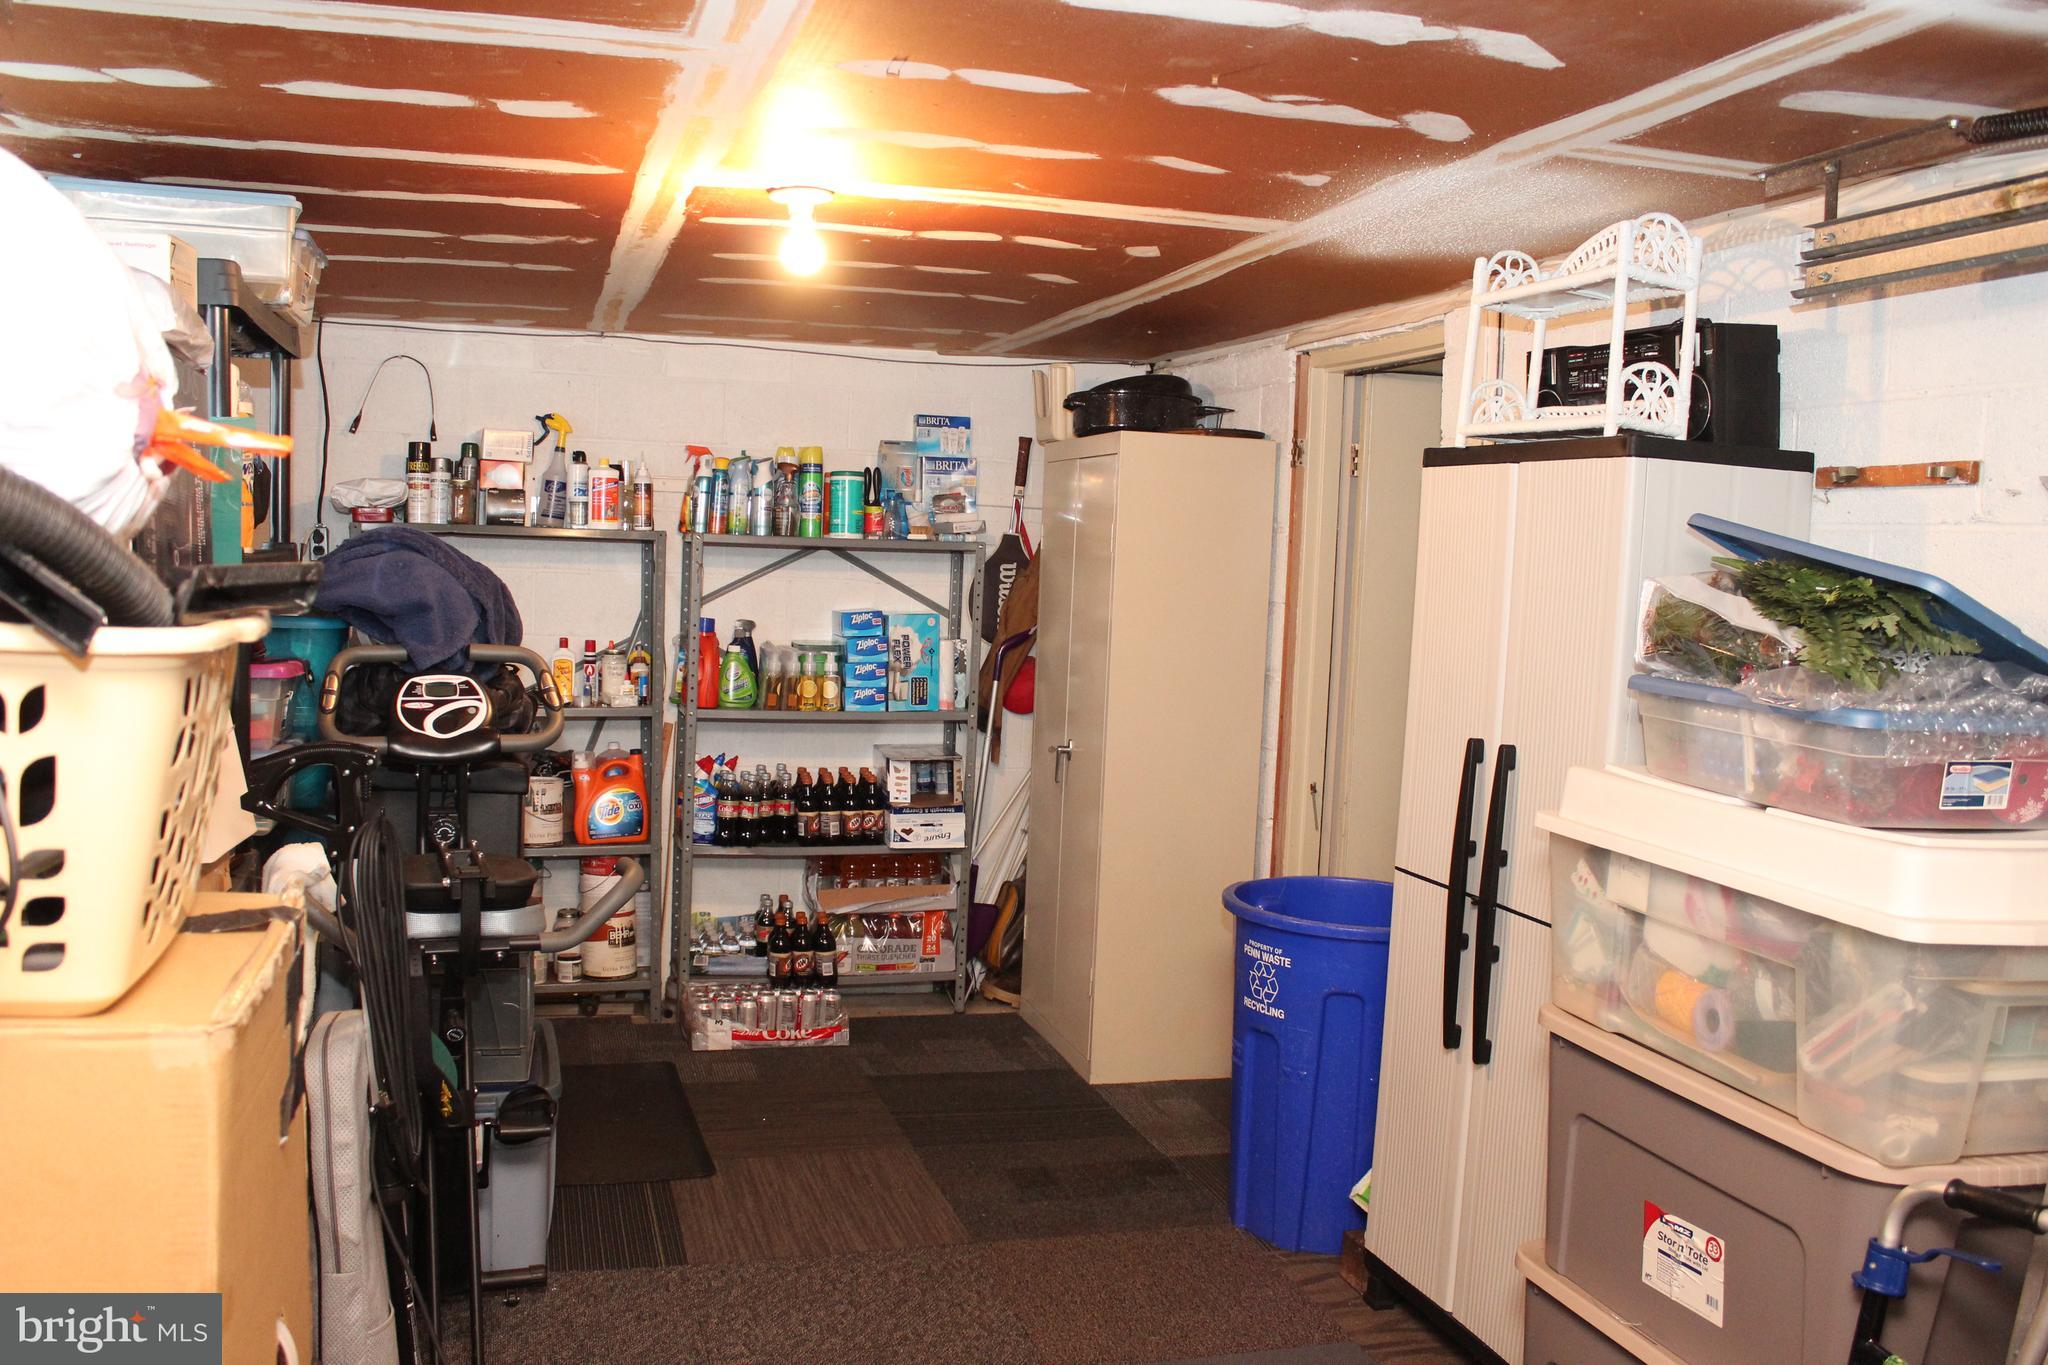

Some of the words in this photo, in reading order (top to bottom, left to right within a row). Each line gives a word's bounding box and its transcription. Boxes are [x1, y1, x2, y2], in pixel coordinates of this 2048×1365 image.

[926, 417, 950, 426] BRITA
[935, 460, 968, 471] BRITA
[996, 562, 1017, 631] Wil
[851, 612, 873, 624] Ziploc
[856, 638, 879, 651] Ziploc
[893, 639, 901, 663] FLEX
[901, 635, 911, 669] POWER
[854, 663, 877, 675] Ziploc
[854, 687, 877, 700] Ziploc
[599, 803, 620, 819] Tide
[628, 802, 642, 810] OXI
[923, 832, 951, 842] Ensure
[857, 945, 917, 954] GORADE
[1249, 939, 1273, 953] PROPERTY
[857, 953, 880, 961] THIRST
[1243, 944, 1261, 959] PENN
[1262, 951, 1292, 968] WASTE
[1243, 996, 1285, 1020] RECYCLING
[763, 1027, 812, 1040] Coke
[1657, 1230, 1677, 1248] Stor
[1709, 1242, 1719, 1256] 33
